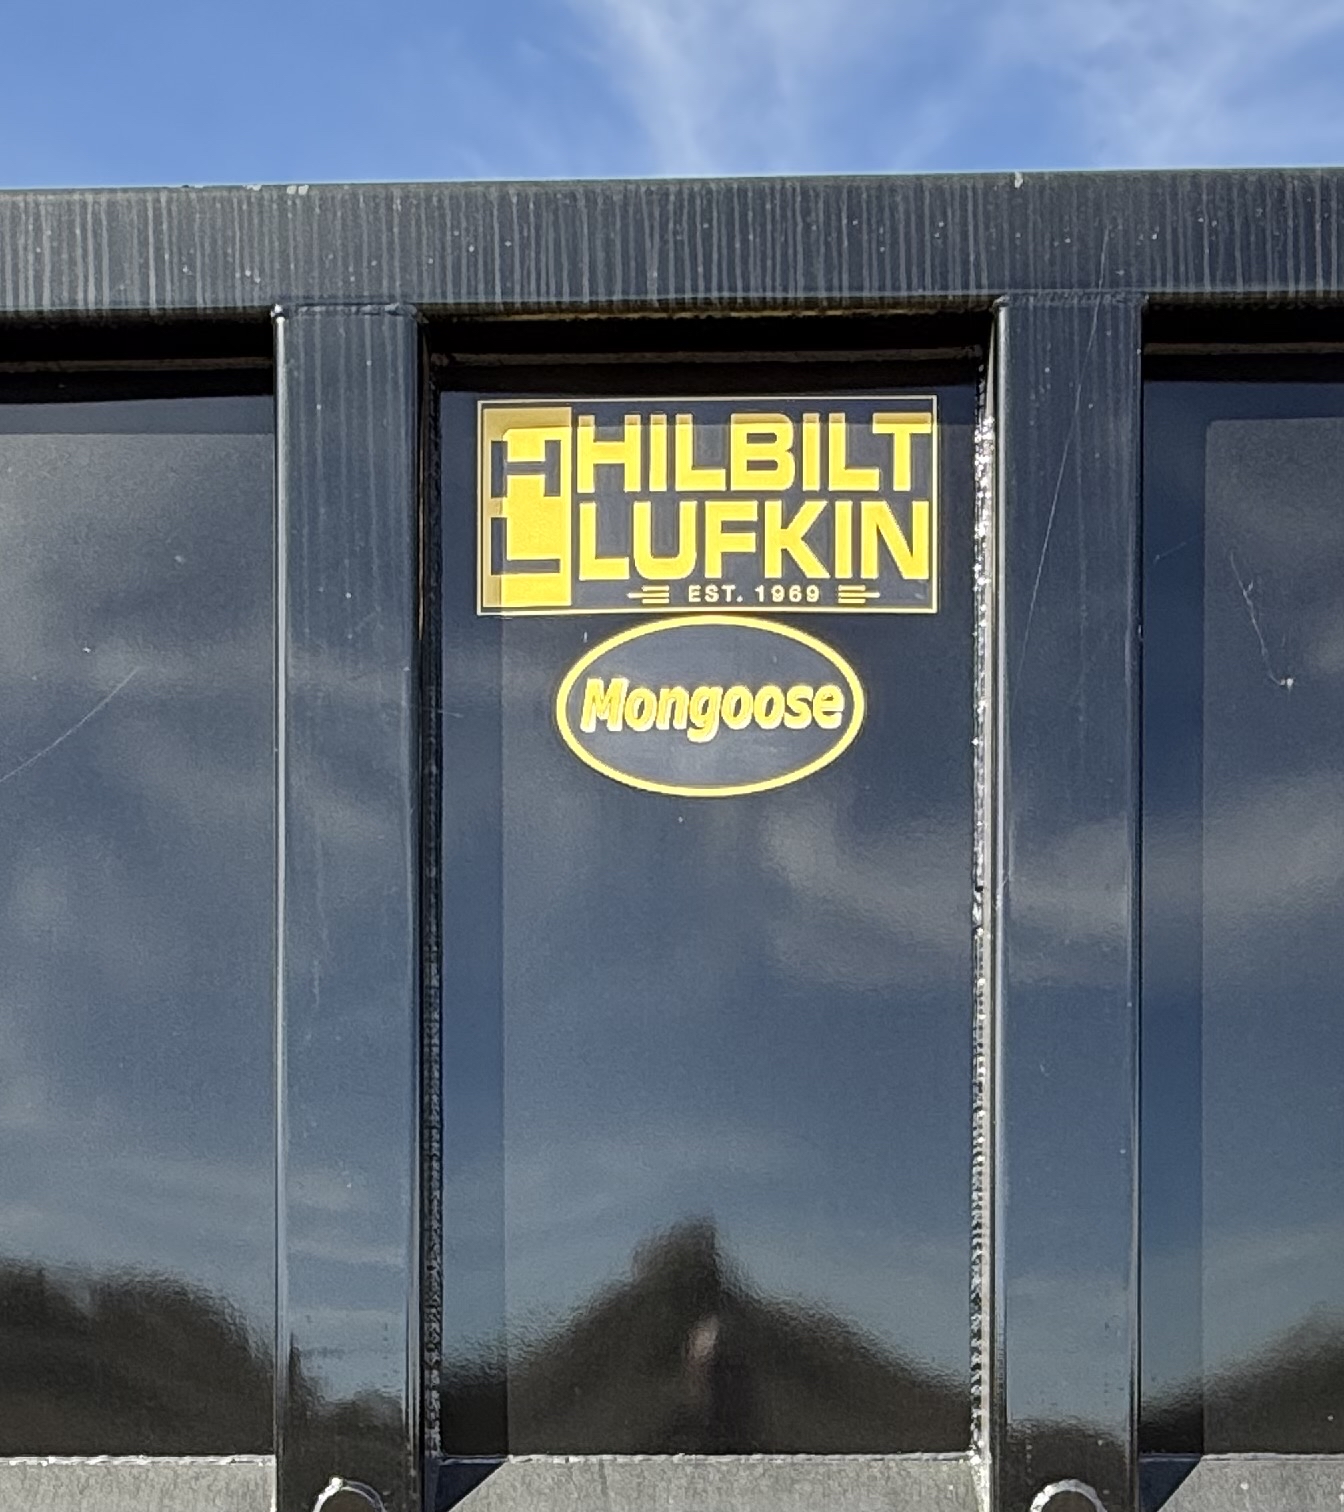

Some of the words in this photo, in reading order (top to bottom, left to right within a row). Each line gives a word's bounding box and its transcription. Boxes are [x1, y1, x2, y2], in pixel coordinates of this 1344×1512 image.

[577, 412, 932, 493] HILBILT
[578, 499, 931, 581] LUFKIN
[688, 583, 744, 603] EST.
[754, 584, 820, 603] 1969
[579, 676, 845, 743] Mongoose
